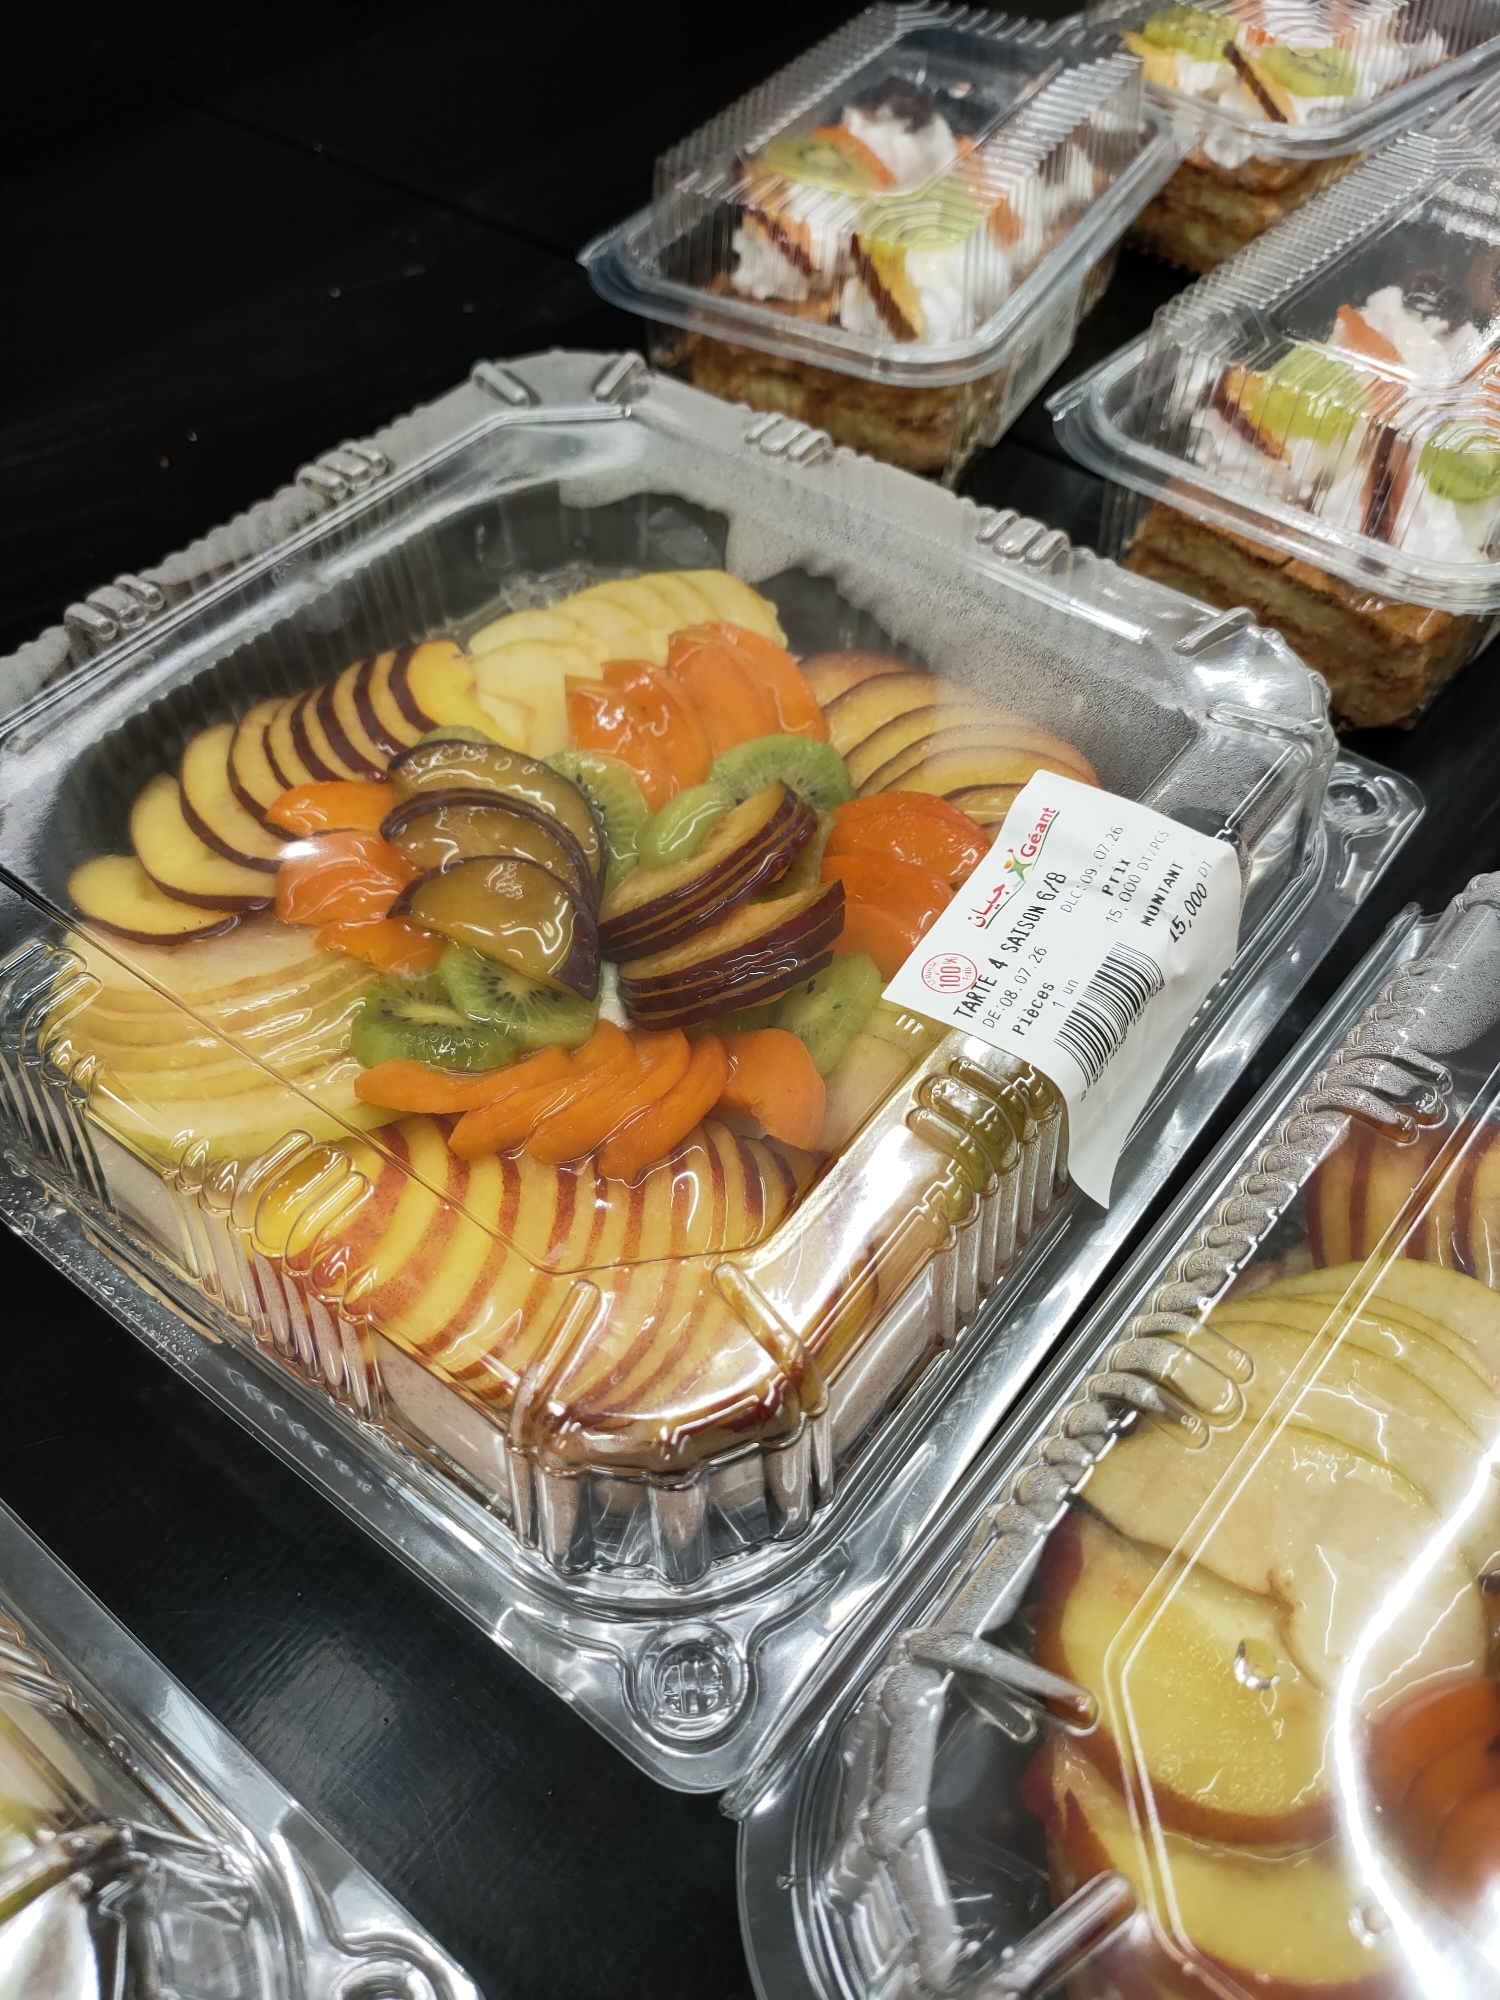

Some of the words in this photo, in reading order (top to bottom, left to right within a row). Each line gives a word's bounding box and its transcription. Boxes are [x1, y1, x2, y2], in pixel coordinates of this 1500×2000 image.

[1020, 807, 1056, 858] Géant
[1137, 829, 1170, 871] DT/PCS
[1101, 858, 1131, 897] Prix
[1140, 860, 1184, 927] MONTANT
[967, 883, 1010, 928] جيان
[1169, 882, 1208, 943] 15,000
[1197, 859, 1213, 878] DT
[953, 974, 998, 1019] TARTE
[988, 957, 1009, 970] 4
[1000, 905, 1047, 953] SAISON
[1037, 872, 1067, 901] 6/8
[939, 956, 961, 987] 100%
[962, 966, 972, 980] Frais
[1053, 1001, 1066, 1009] 1
[1062, 979, 1079, 995] un
[1012, 982, 1055, 1036] Pièces
